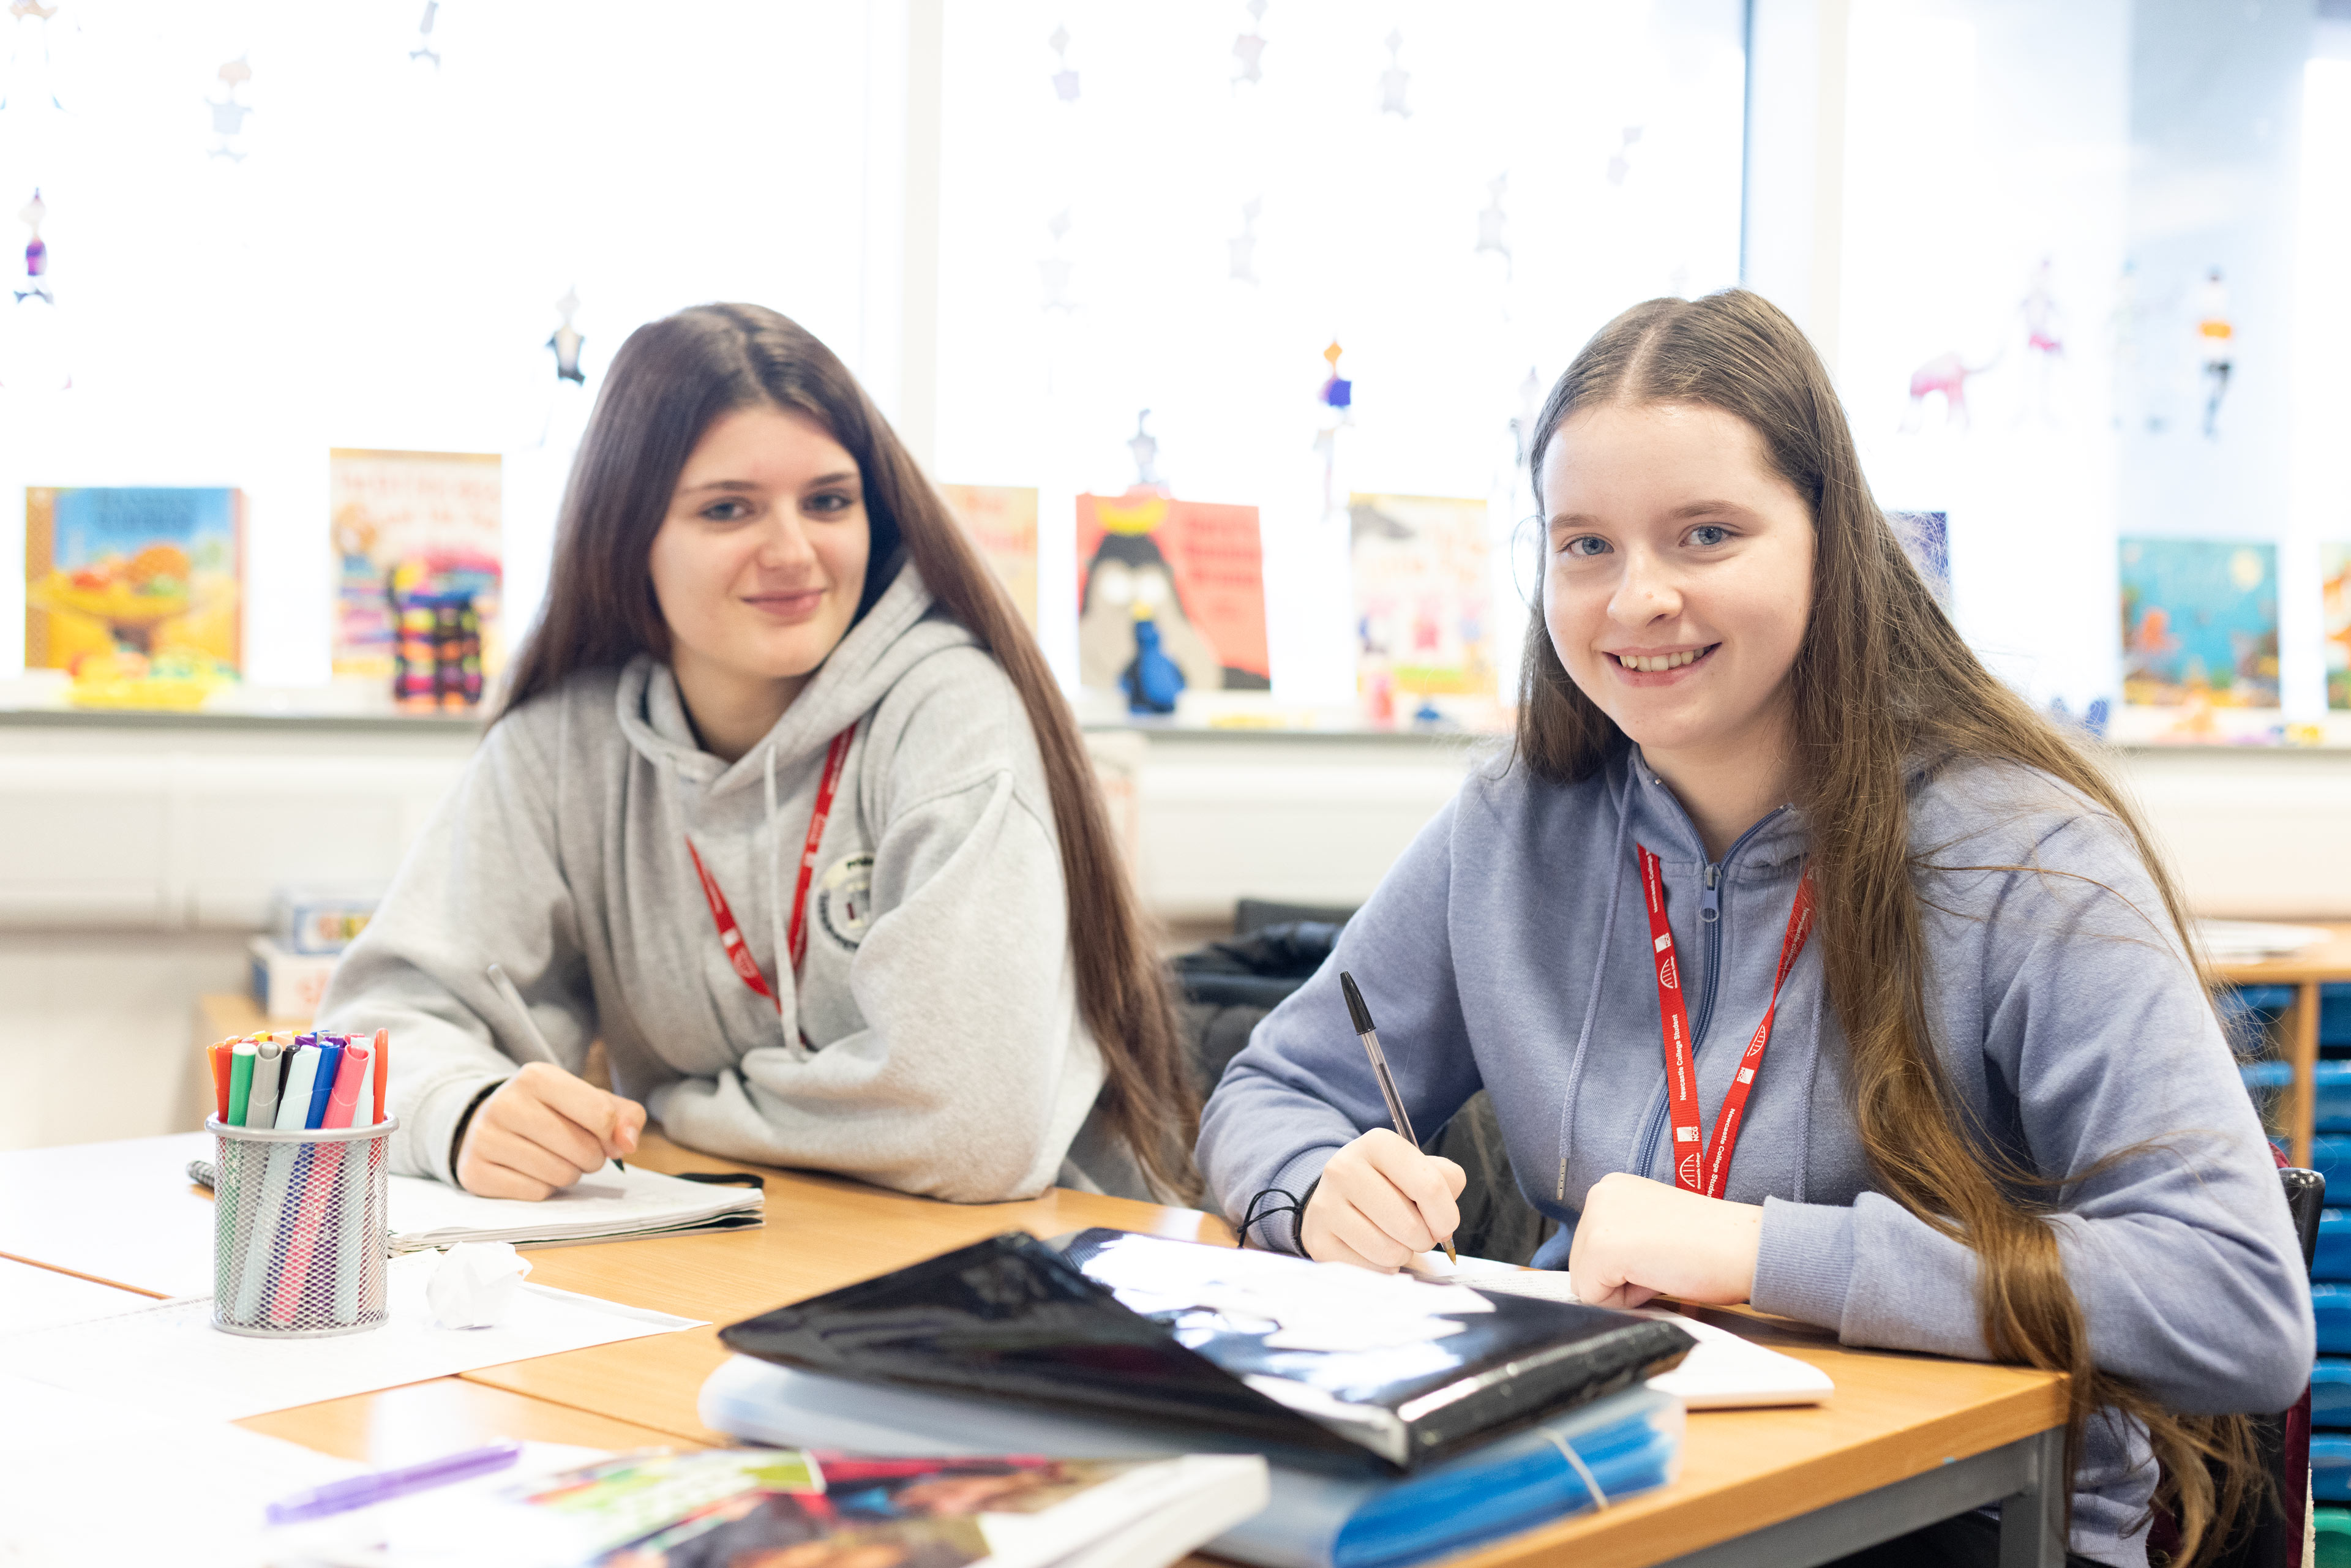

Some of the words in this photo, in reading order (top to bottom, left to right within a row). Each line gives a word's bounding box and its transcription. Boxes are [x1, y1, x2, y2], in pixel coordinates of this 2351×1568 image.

[1793, 907, 1810, 942] Newcastle
[1672, 1014, 1681, 1040] Student
[1678, 1067, 1687, 1101] Newcastle
[1736, 1067, 1745, 1082] NCG
[1720, 1108, 1736, 1145] Newcastle
[1713, 1146, 1725, 1173] College
[1706, 1173, 1718, 1198] Studen
